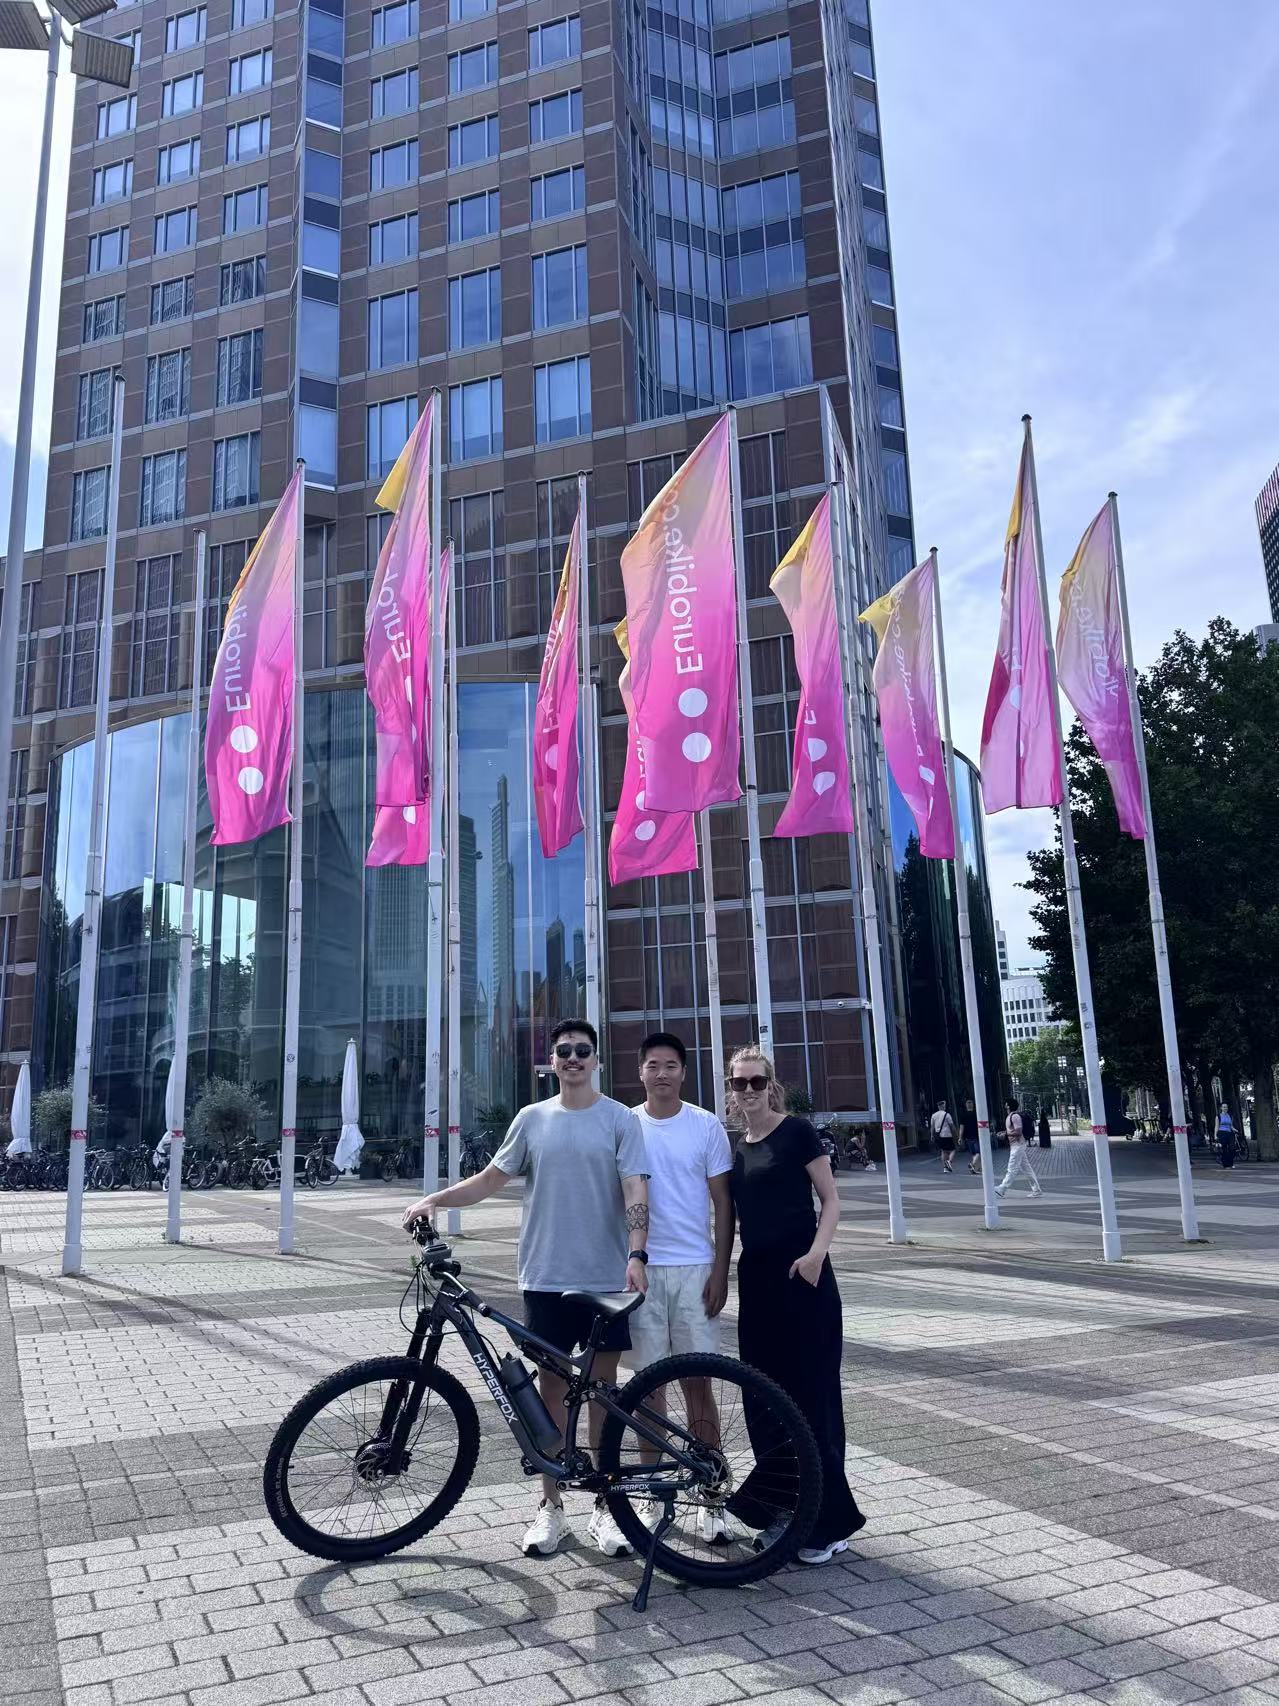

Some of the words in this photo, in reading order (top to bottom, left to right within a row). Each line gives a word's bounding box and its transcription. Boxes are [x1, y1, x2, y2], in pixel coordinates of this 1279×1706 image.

[473, 1352, 518, 1424] HYPERFOX
[610, 1483, 650, 1491] HYPERFOX
[275, 1490, 288, 1518] KENDA
